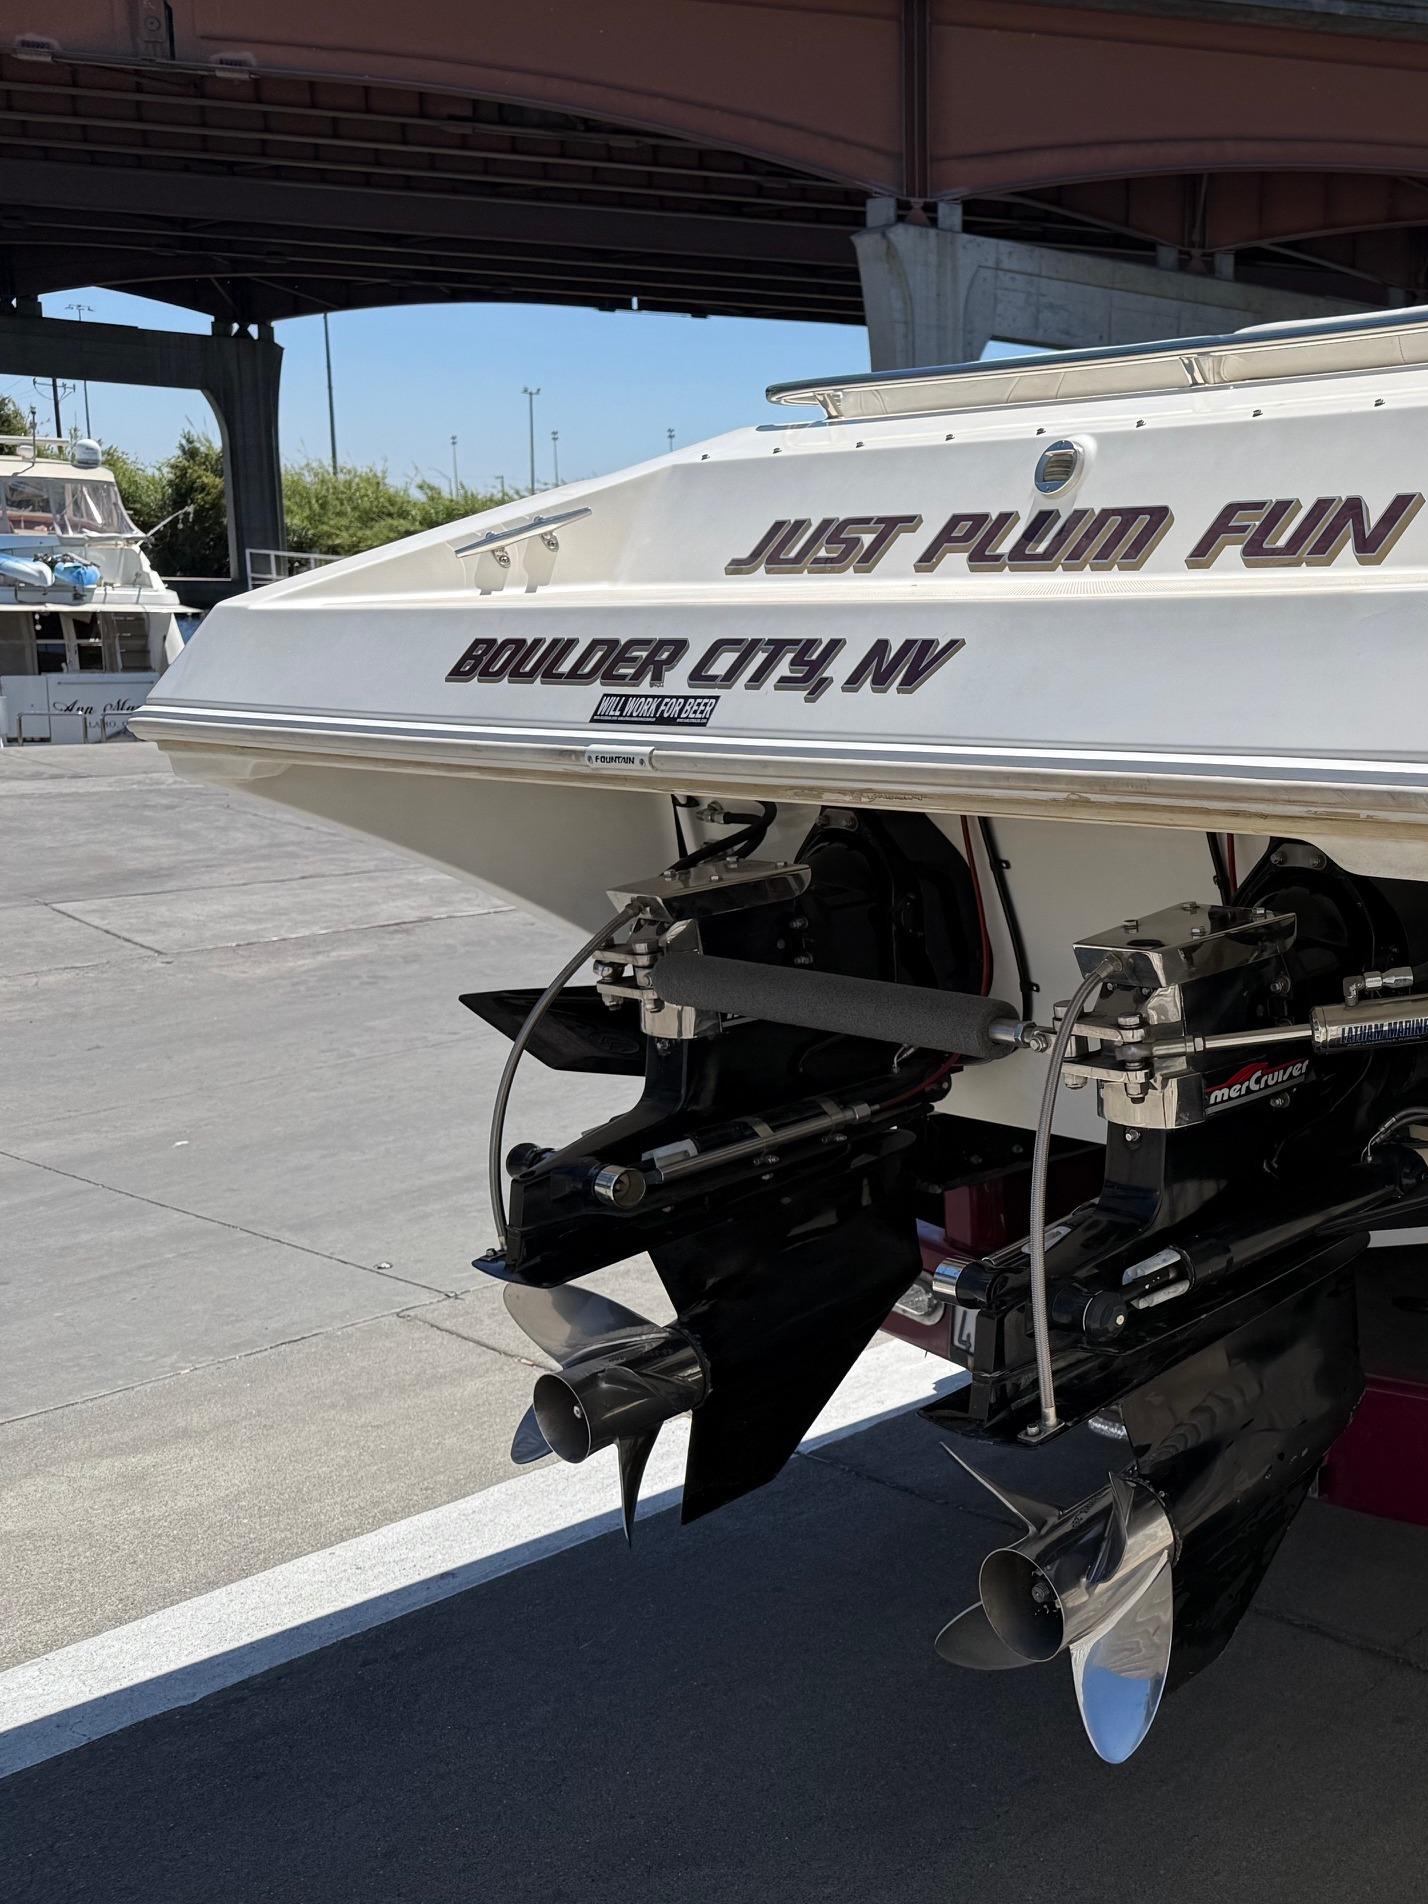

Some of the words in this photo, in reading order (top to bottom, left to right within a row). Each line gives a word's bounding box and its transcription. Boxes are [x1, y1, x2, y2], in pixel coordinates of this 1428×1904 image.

[724, 513, 923, 576] JUST
[913, 504, 1175, 573] PLUM
[1184, 491, 1426, 570] FUN
[445, 637, 690, 687] BOULDER
[688, 637, 847, 703] CITY,
[841, 637, 967, 694] NV
[597, 696, 625, 716] WILL
[622, 697, 662, 717] WORK
[656, 698, 685, 718] FOR
[680, 698, 716, 719] BEER
[595, 755, 635, 765] FOUNTAIN
[1341, 1023, 1386, 1044] LATHAM
[1209, 1059, 1309, 1104] merCruiser
